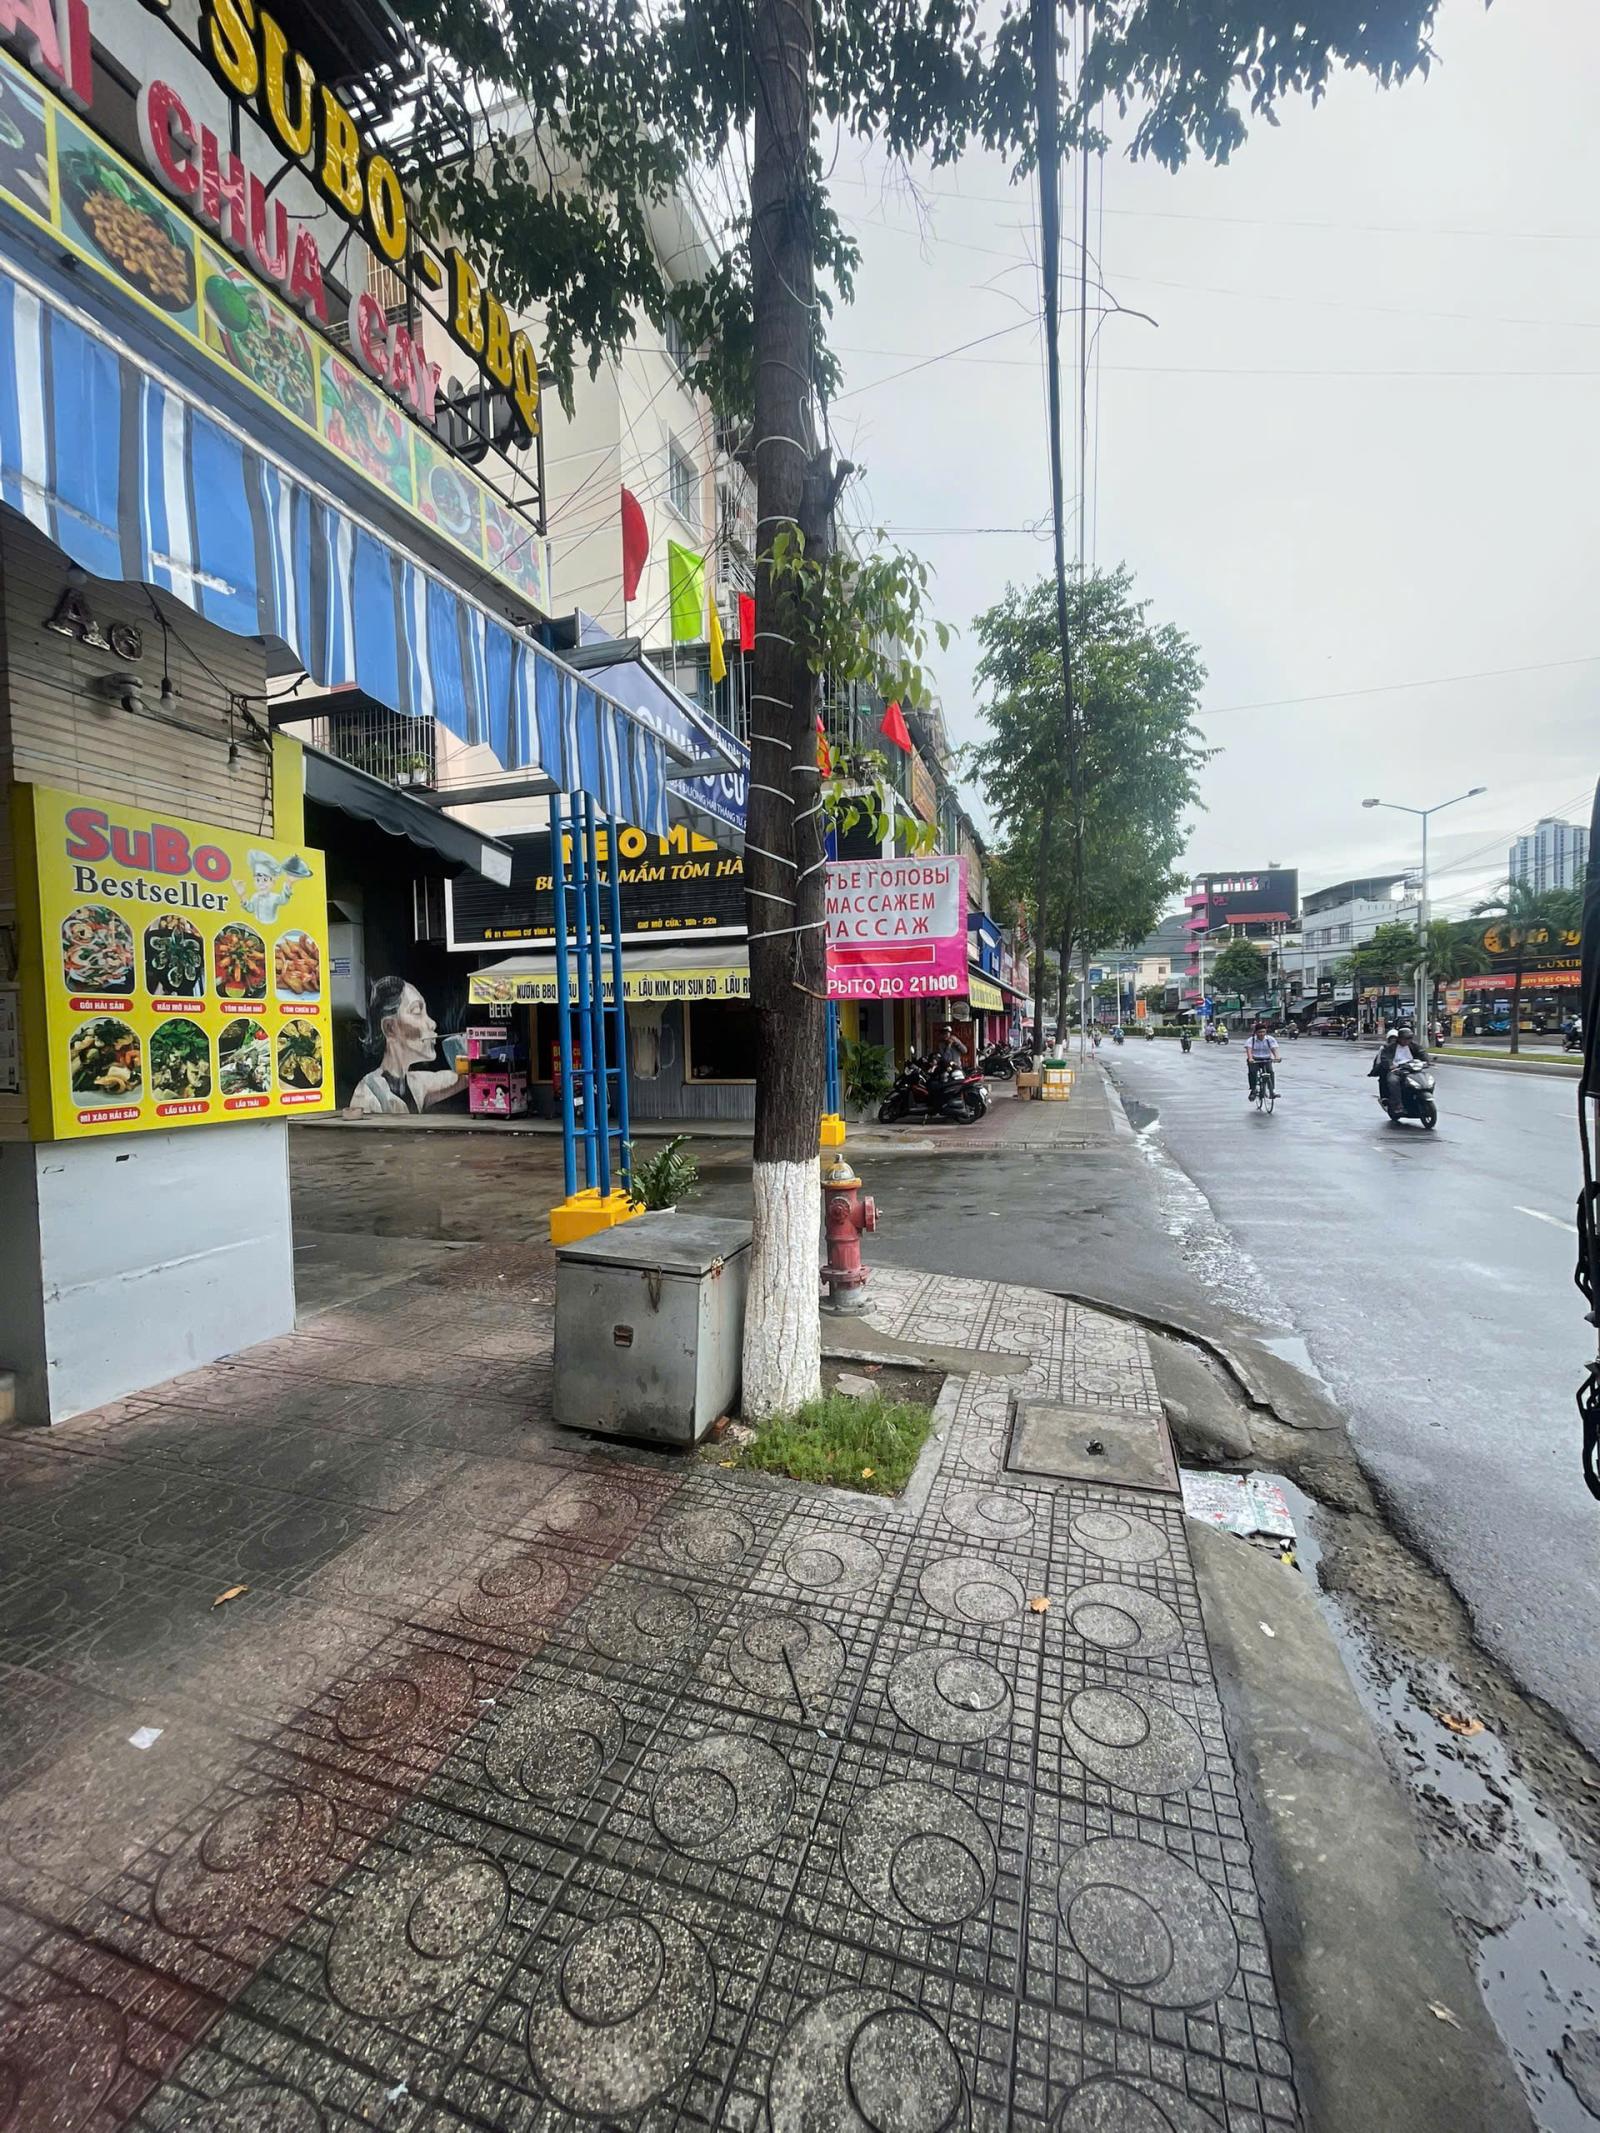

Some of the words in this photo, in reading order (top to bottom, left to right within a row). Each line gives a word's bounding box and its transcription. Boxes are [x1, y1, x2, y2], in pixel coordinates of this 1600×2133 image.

[452, 249, 540, 436] BBQ
[670, 861, 710, 880] TÔM
[868, 867, 950, 888] ГОЛОВЫ
[71, 864, 229, 912] Bestseller
[826, 892, 936, 915] МАССАЖЕМ
[542, 983, 557, 999] BBQ
[655, 979, 671, 996] KIM
[673, 979, 686, 996] CHI
[878, 976, 904, 996] ДО
[909, 975, 958, 993] 21h00
[489, 1003, 513, 1019] BEER
